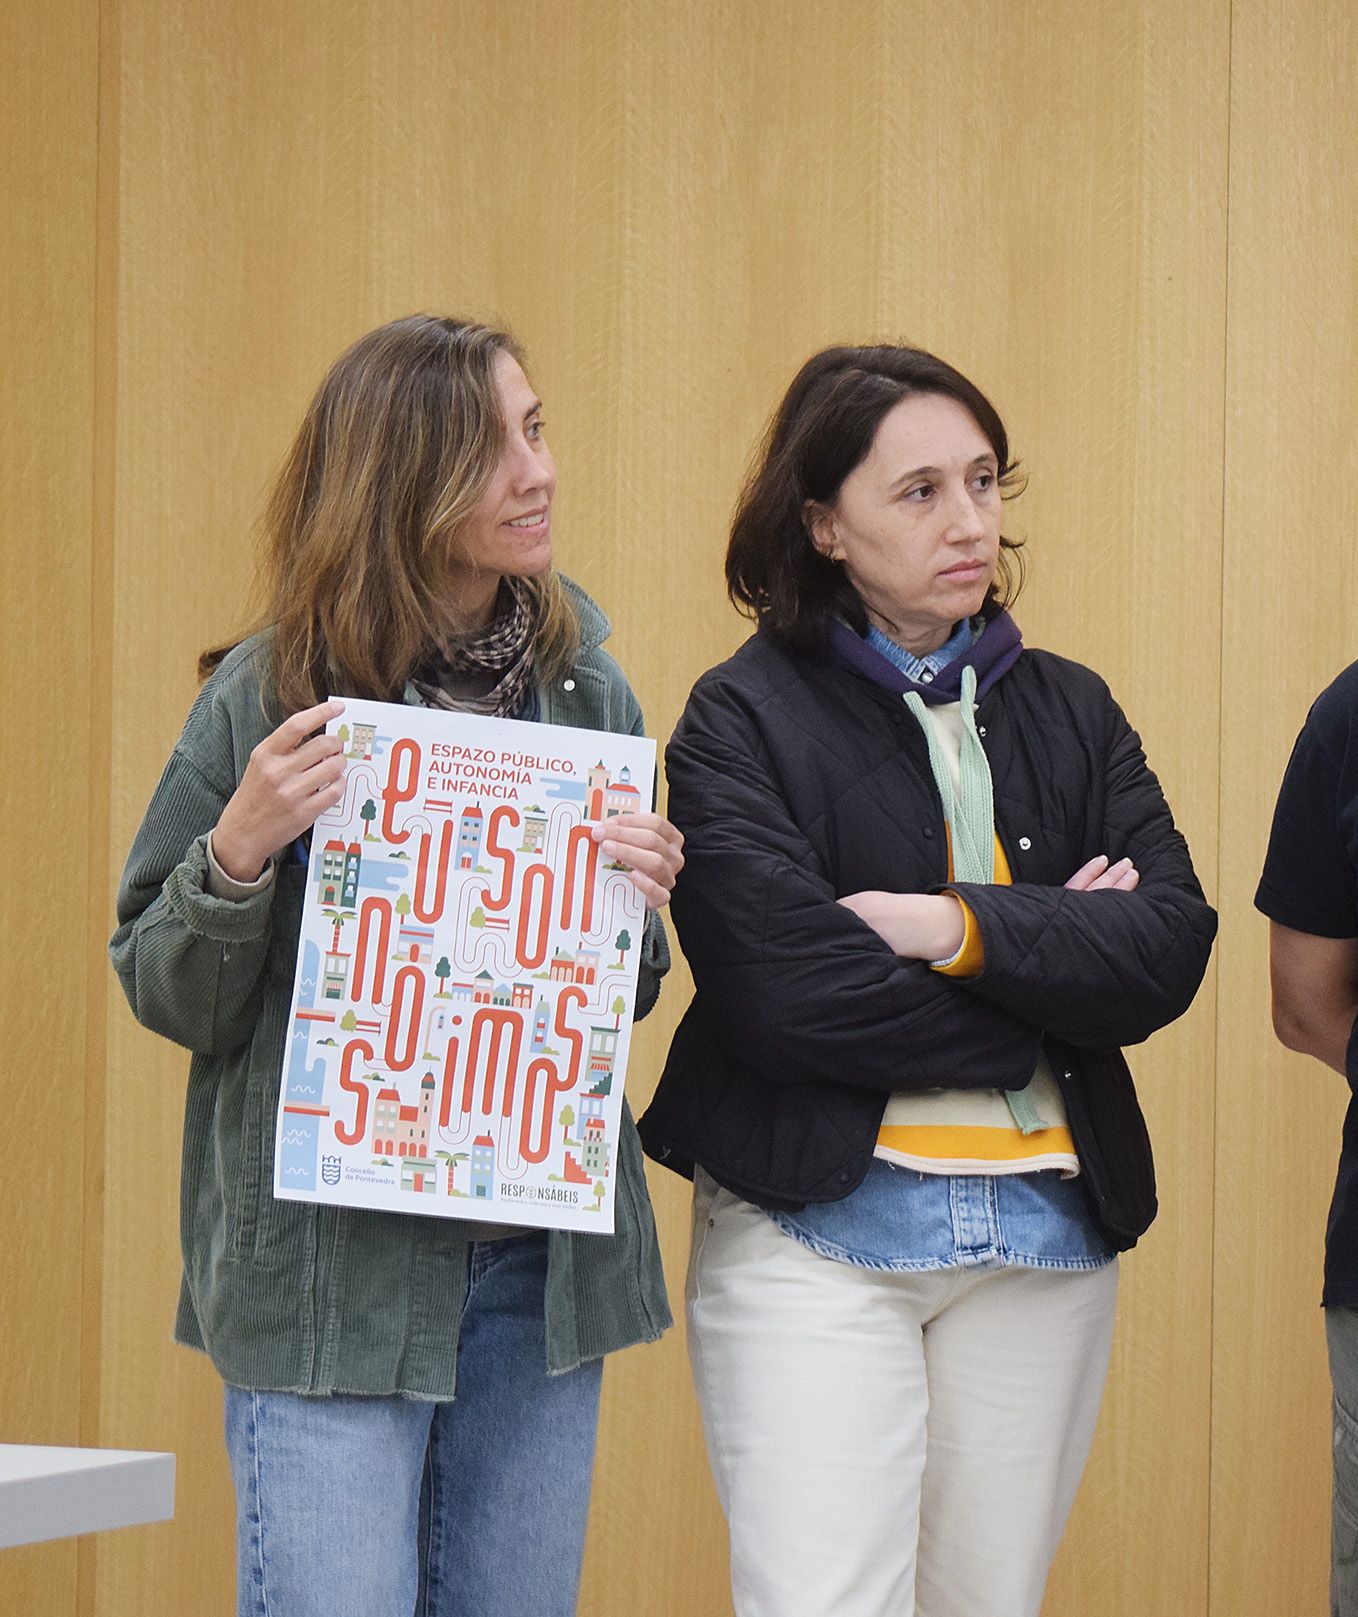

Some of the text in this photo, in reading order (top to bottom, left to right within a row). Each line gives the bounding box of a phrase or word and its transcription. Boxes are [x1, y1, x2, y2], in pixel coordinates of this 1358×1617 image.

[431, 743, 577, 776] ESPAZO PÚBLICO,
[429, 760, 532, 785] AUTONOMÍA
[427, 776, 519, 800] E INFANCIA
[345, 1166, 376, 1175] Concello
